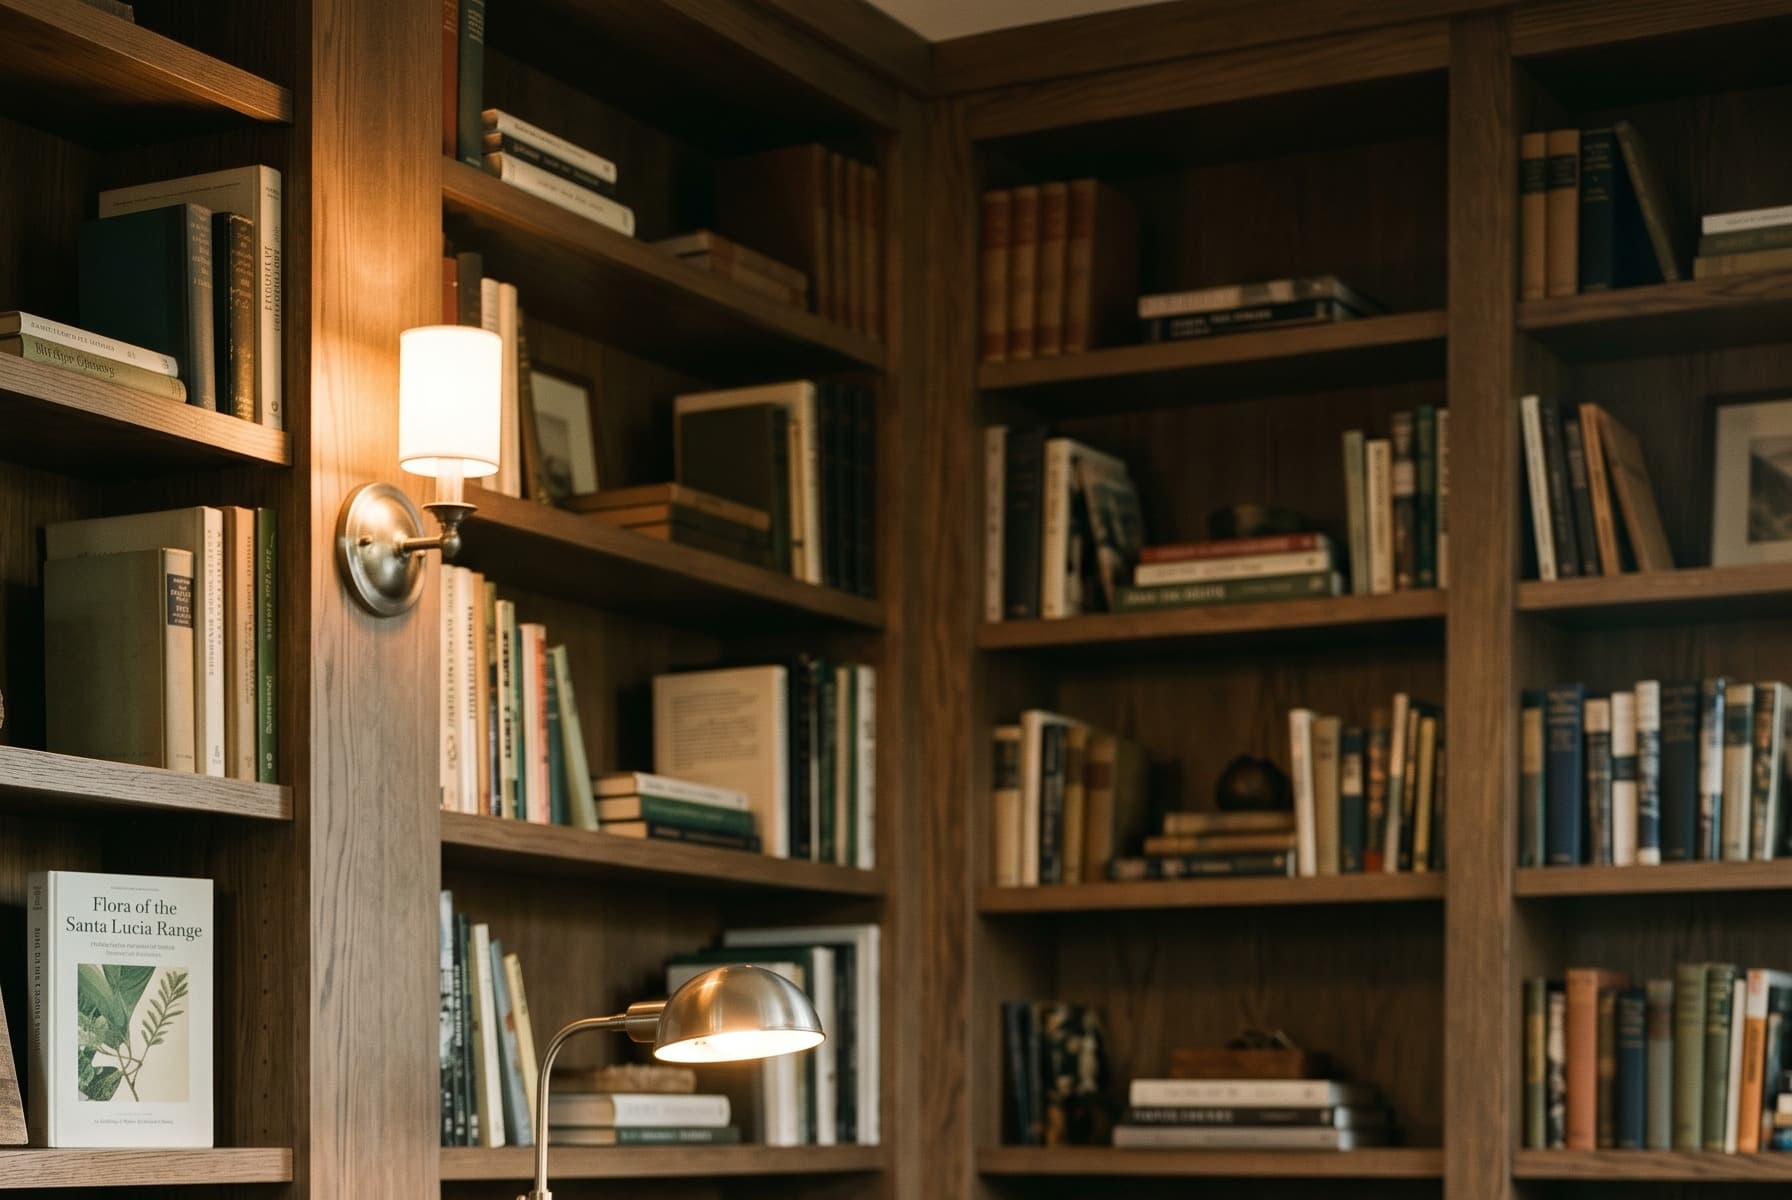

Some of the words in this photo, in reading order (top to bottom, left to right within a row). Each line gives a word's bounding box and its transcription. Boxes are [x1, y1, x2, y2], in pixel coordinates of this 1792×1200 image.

[93, 896, 131, 912] Flora
[135, 899, 152, 914] of
[154, 899, 177, 915] the
[66, 916, 107, 933] Santa
[111, 919, 152, 936] Lucia
[157, 920, 202, 942] Range
